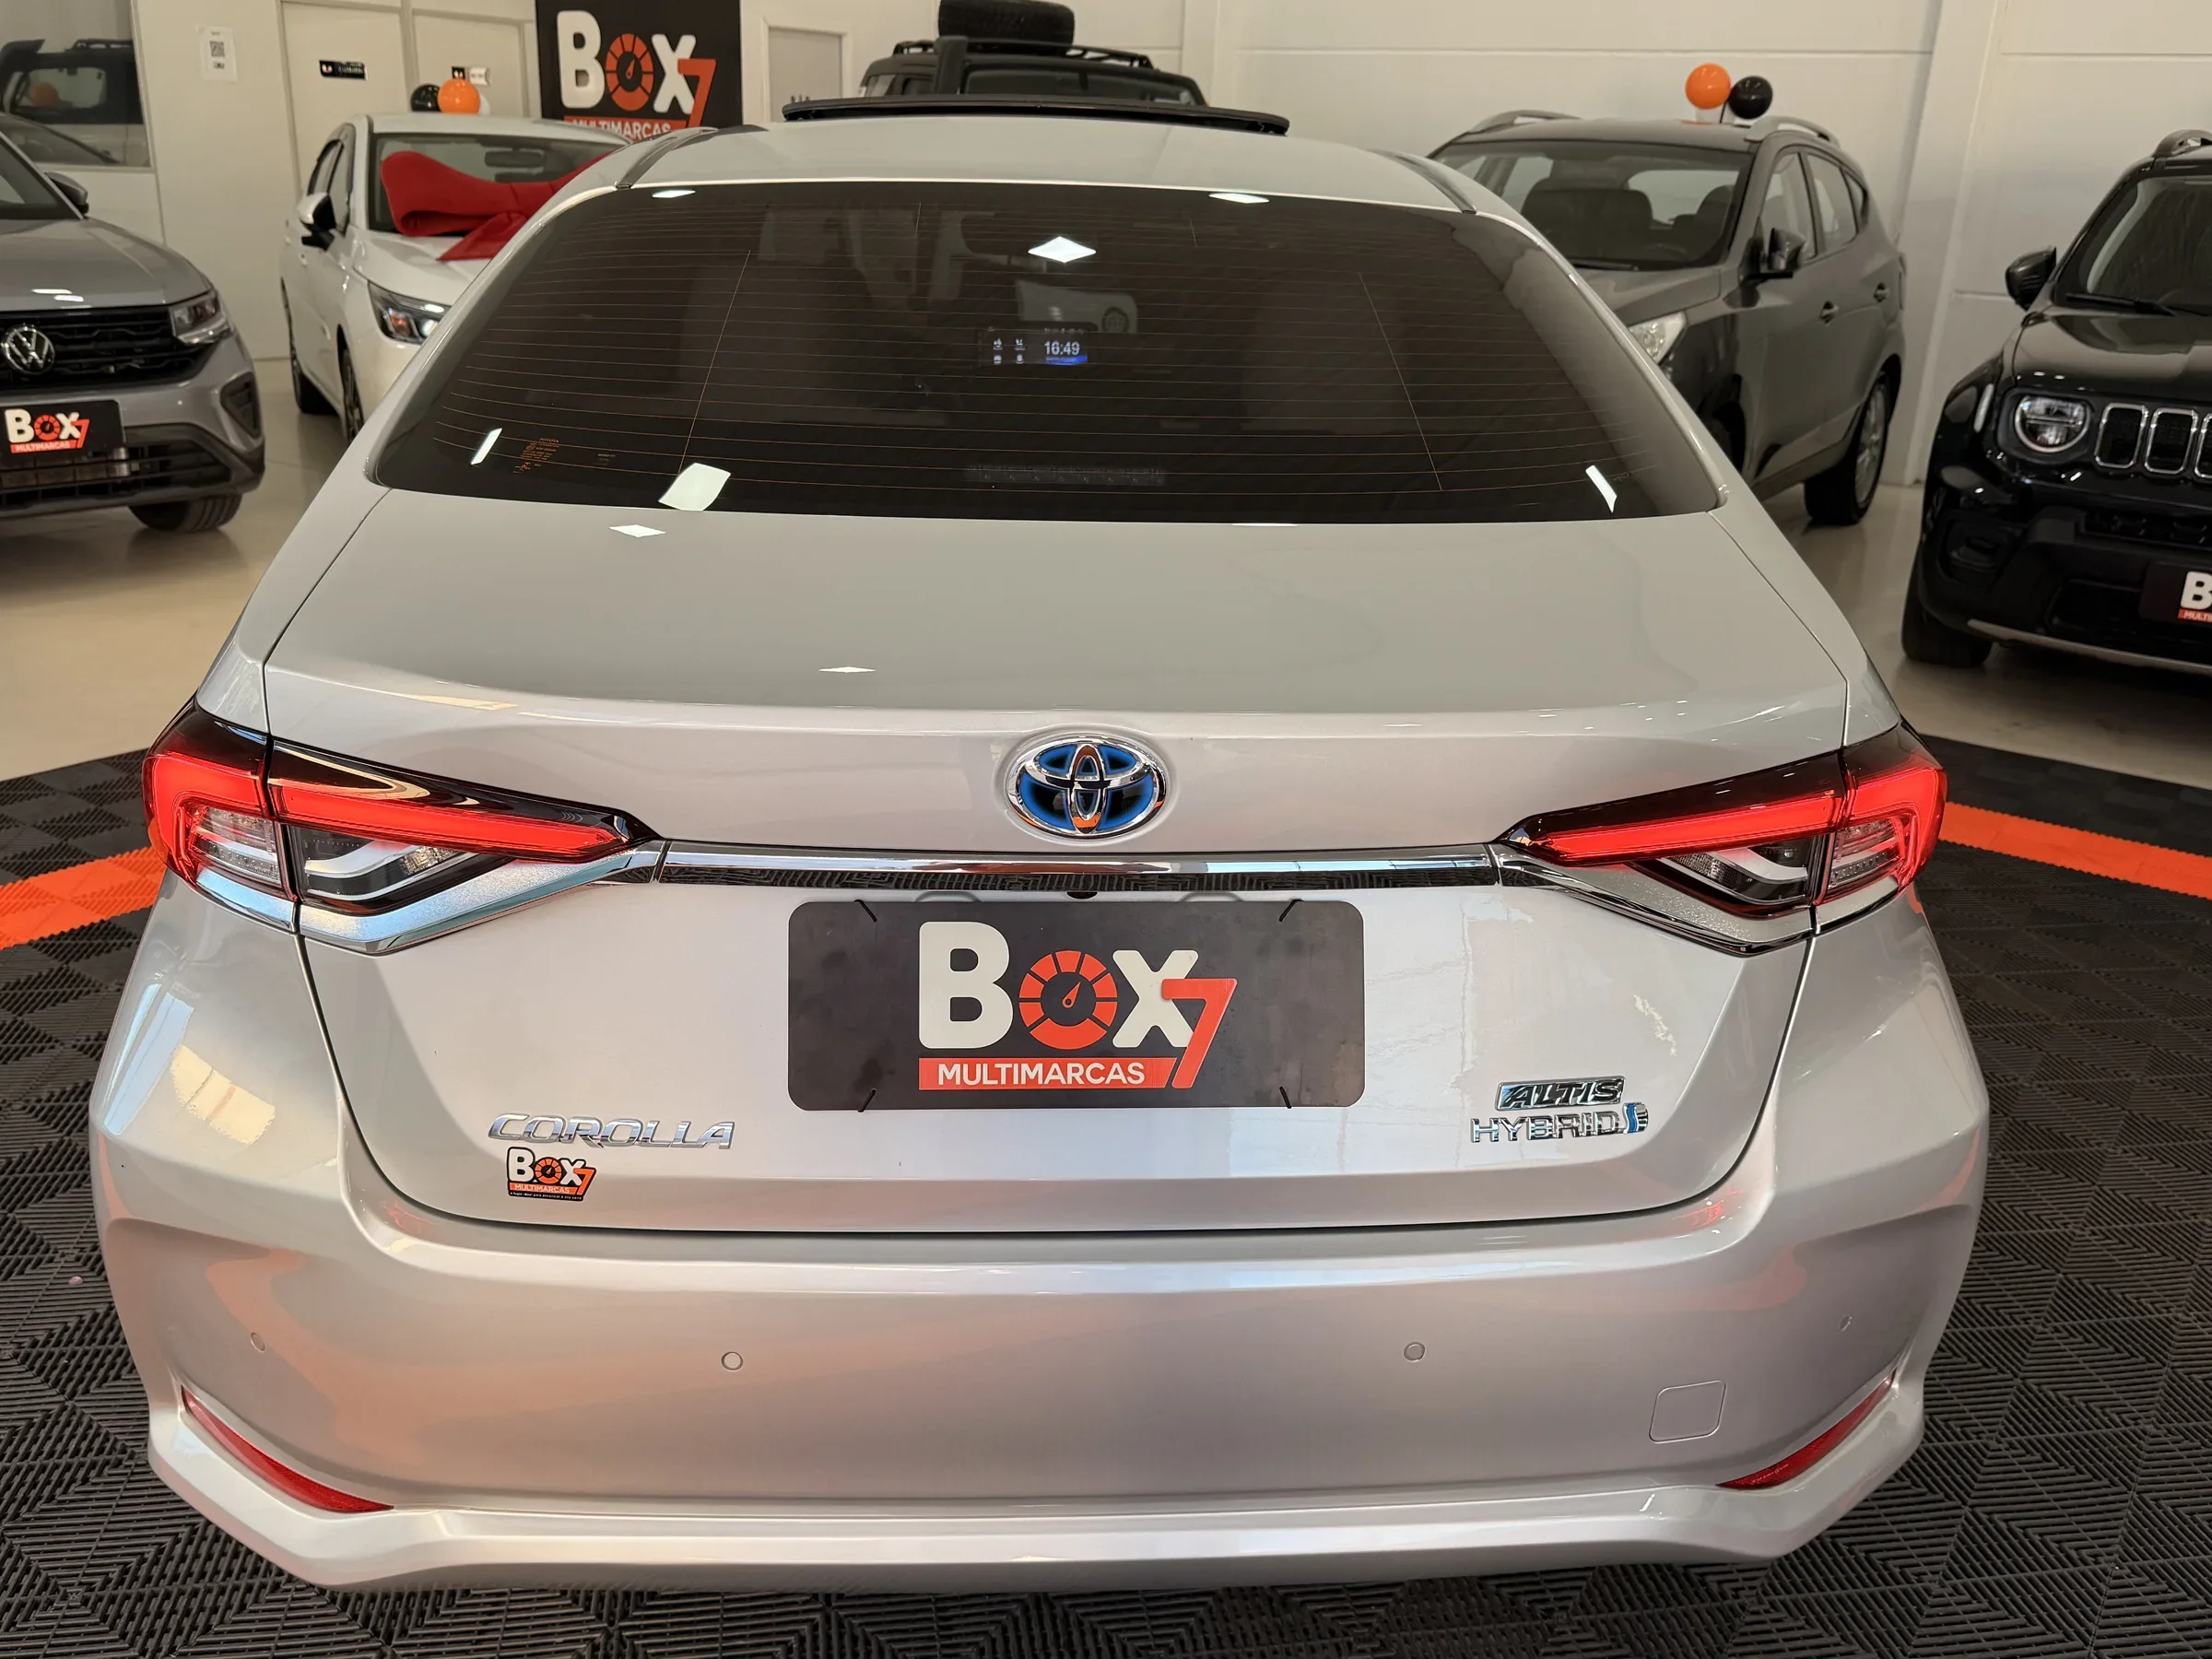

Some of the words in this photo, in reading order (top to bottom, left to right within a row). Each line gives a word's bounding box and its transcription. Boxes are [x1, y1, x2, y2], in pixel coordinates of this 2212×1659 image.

[1043, 341, 1080, 356] 16:49
[17, 440, 71, 453] MULTIMARCAS
[938, 1063, 1145, 1086] MULTIMARCAS
[1503, 1078, 1624, 1109] ALTIS
[488, 1113, 735, 1149] COROLLA
[1471, 1111, 1620, 1144] HYBRID
[514, 1182, 571, 1194] MULTIMARCAS
